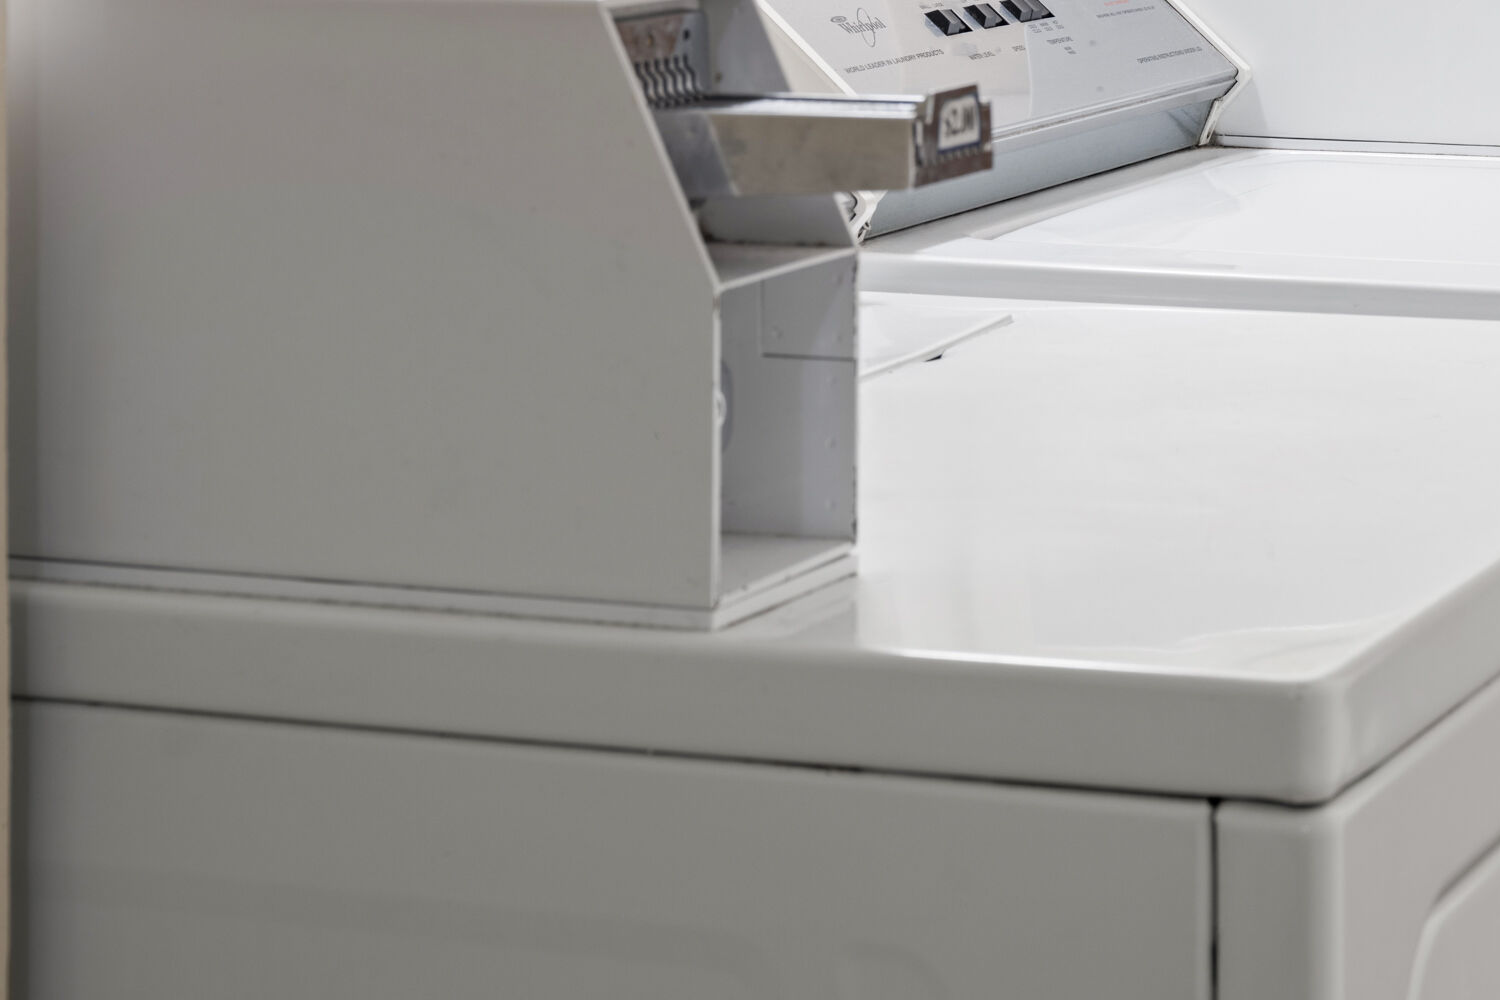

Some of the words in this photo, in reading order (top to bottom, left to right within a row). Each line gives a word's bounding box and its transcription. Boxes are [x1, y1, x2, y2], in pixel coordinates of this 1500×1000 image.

[844, 64, 866, 74] WORLD
[865, 61, 886, 71] LEADER
[891, 55, 916, 65] LAUNDRY
[916, 49, 944, 59] PRODUCTS
